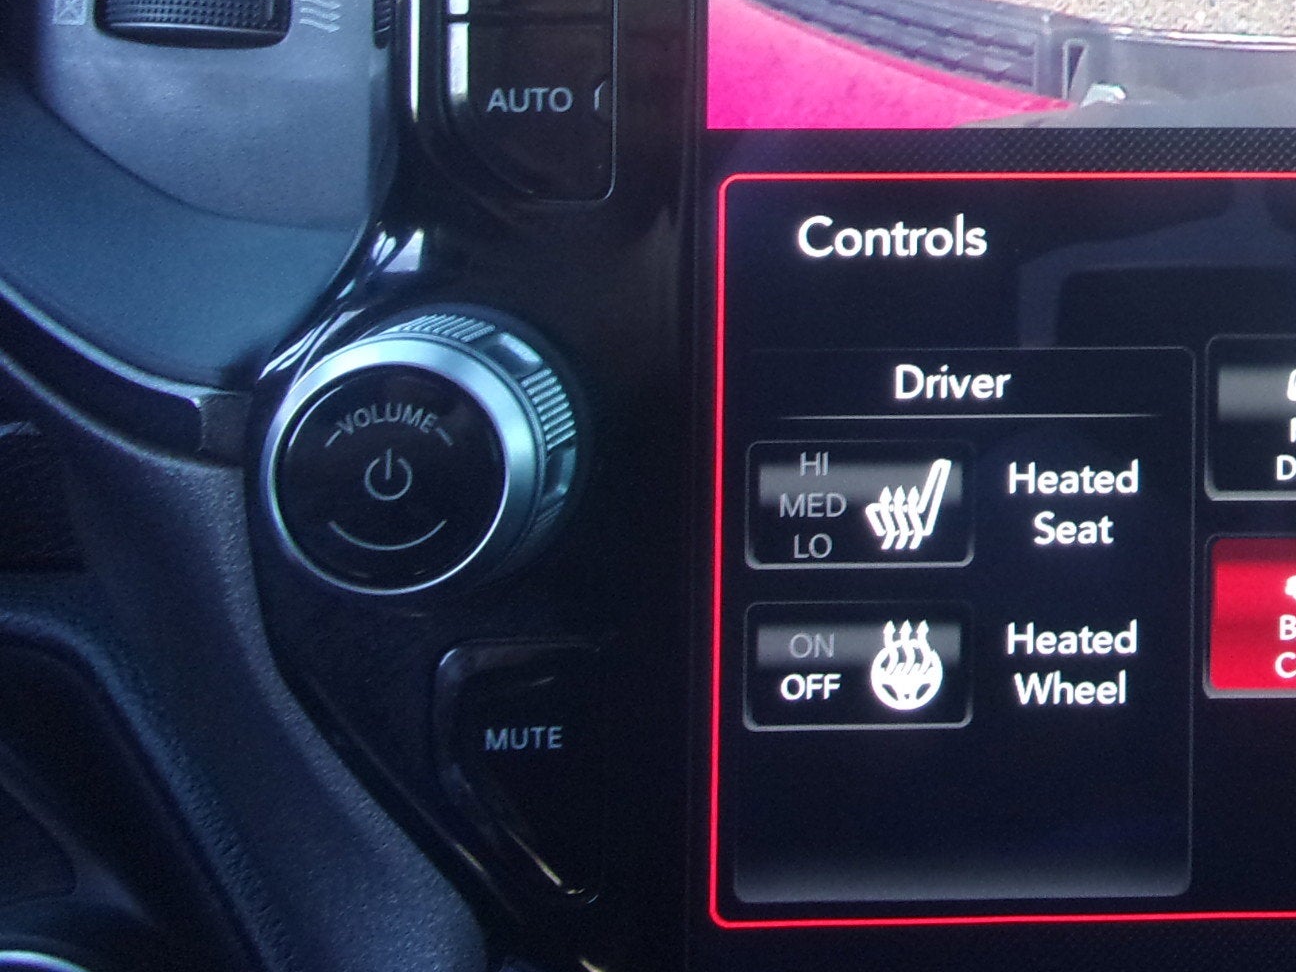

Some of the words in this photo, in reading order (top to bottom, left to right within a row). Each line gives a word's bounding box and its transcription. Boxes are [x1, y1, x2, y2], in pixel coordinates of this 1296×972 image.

[487, 86, 573, 113] AUTO
[796, 214, 988, 258] Controls
[894, 364, 1011, 401] Driver
[337, 402, 439, 436] VOLUME
[799, 452, 829, 477] HI
[1007, 459, 1140, 495] Heated
[779, 493, 847, 519] MED
[1033, 511, 1114, 546] Seat
[793, 533, 832, 559] LO
[789, 633, 836, 659] ON
[1006, 619, 1138, 656] Heated
[780, 673, 842, 701] OFF
[1014, 670, 1127, 706] Wheel
[484, 726, 563, 751] MUTE
